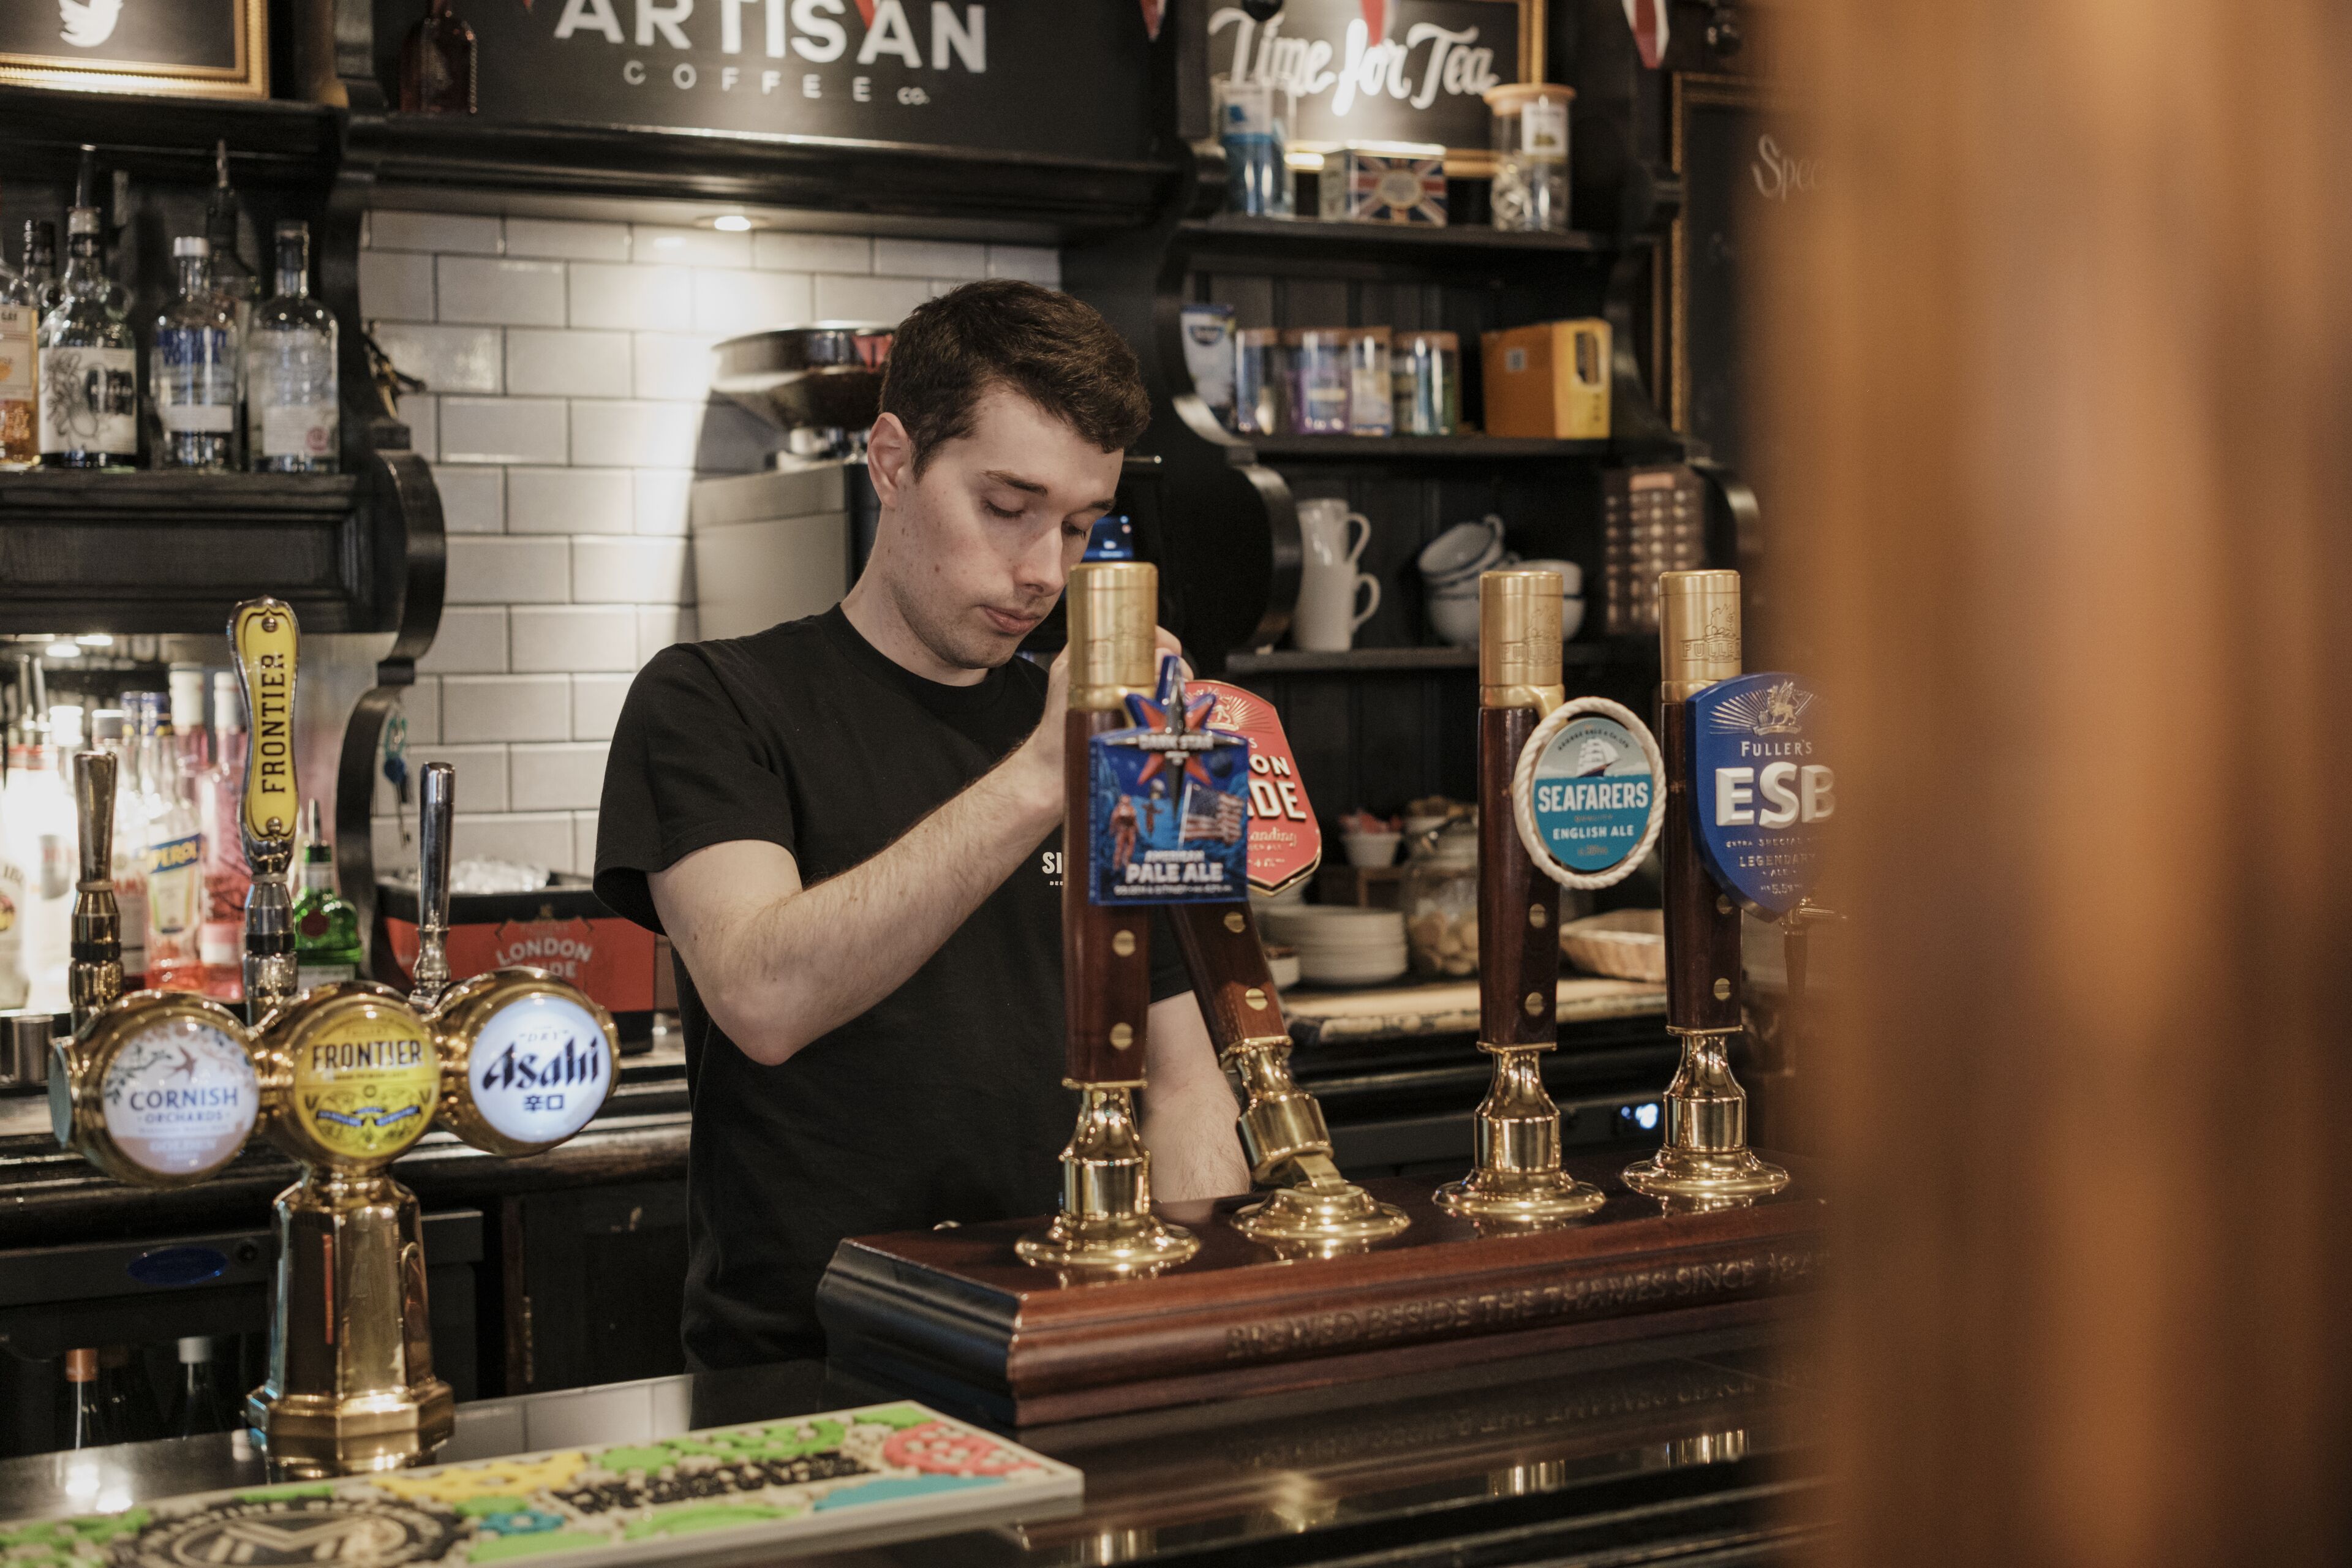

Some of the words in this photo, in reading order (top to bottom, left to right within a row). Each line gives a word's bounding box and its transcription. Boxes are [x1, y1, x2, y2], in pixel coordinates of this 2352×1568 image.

[554, 0, 987, 72] ARTISAN
[1208, 6, 1337, 97] Time
[1331, 18, 1412, 116] for
[1407, 22, 1501, 110] Tea
[623, 60, 872, 103] COFFEE
[261, 653, 285, 794] FRONTIER
[1741, 739, 1812, 758] FULLER'S
[1537, 782, 1649, 813] SEAFARERS
[1715, 761, 1836, 829] ESB
[1553, 826, 1607, 840] ENGLISH
[1610, 824, 1635, 837] ALE
[1125, 862, 1181, 884] PALE
[1182, 862, 1224, 883] ALE
[496, 937, 594, 965] LONDON
[312, 1039, 424, 1071] FRONTIER
[483, 1036, 598, 1090] Asahi
[130, 1087, 239, 1111] CORNISH
